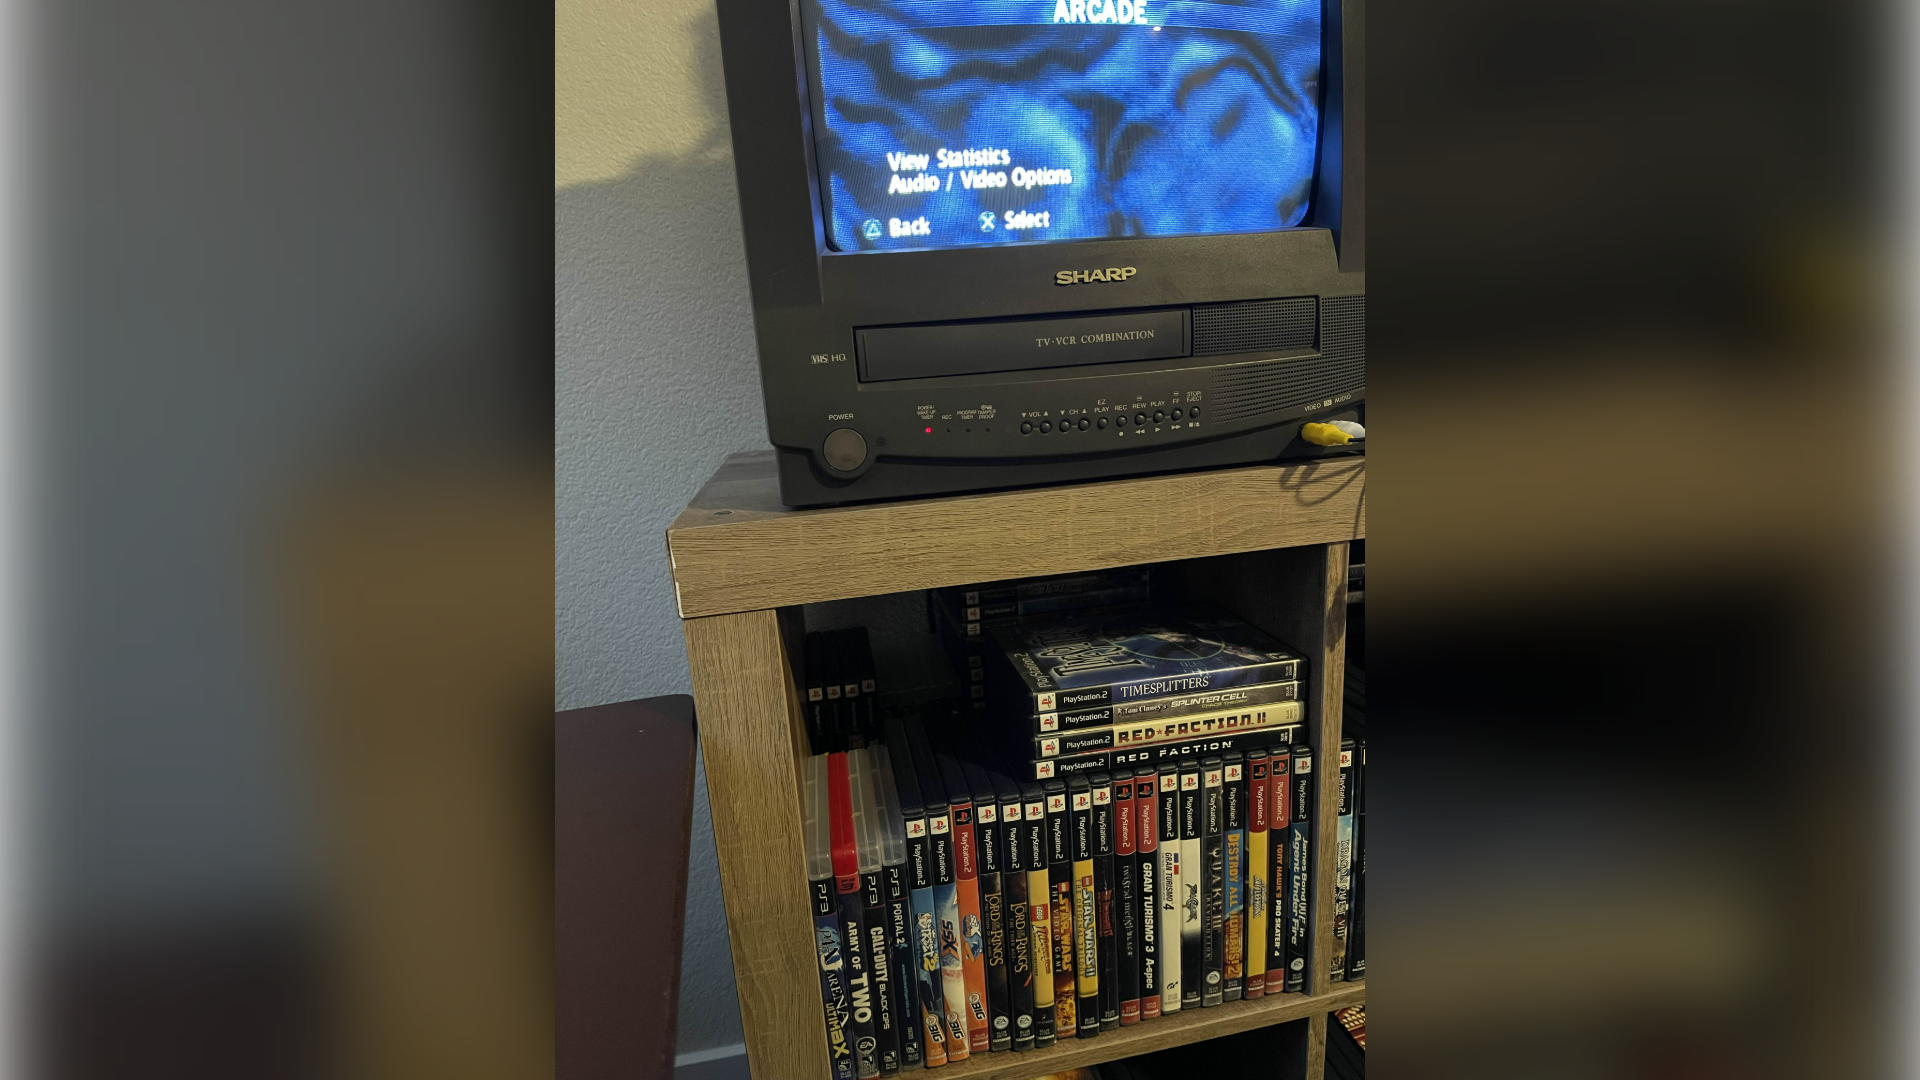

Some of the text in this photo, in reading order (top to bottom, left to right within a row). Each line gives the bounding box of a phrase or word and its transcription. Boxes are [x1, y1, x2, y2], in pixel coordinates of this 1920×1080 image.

[1053, 0, 1148, 24] ARCADE
[887, 148, 1011, 172] View Statistics
[888, 173, 941, 196] Audio
[959, 169, 1008, 190] Video
[1011, 166, 1073, 191] Options
[888, 209, 1050, 238] Back Select
[1056, 266, 1137, 285] SHARP
[1080, 329, 1155, 345] COMBINATION
[811, 354, 829, 364] VHS
[829, 413, 854, 421] POWER
[1304, 393, 1352, 412] VIDEO AUDIO
[1120, 676, 1210, 697] TIMESPLITTERS
[1170, 695, 1220, 708] SPLINTER
[1220, 692, 1248, 701] CELL
[1118, 727, 1155, 743] RED
[1164, 714, 1252, 736] FACTION
[1257, 712, 1266, 724] II
[1117, 752, 1149, 763] RED
[1159, 741, 1232, 757] FACTION
[1165, 852, 1173, 870] GRAN
[1228, 833, 1240, 883] DESTROY
[1338, 839, 1350, 884] DRAGON
[890, 868, 901, 897] PS3
[1143, 862, 1153, 893] GRAN
[1165, 872, 1174, 902] TURISMO
[1208, 847, 1222, 910] QUAKE
[1275, 868, 1283, 899] HAWK'S
[1291, 828, 1302, 945] Agent Under Fire
[985, 891, 1001, 921] LORD
[1082, 888, 1094, 928] STAR
[1163, 903, 1174, 911] 4
[1229, 886, 1238, 907] ALL
[1337, 885, 1348, 915] QUEST
[893, 903, 904, 937] PORTAL
[1010, 901, 1027, 930] LORD
[1058, 893, 1071, 933] STAR
[1143, 895, 1154, 942] TURISMO
[1212, 915, 1222, 929] III
[942, 919, 960, 958] SSX
[1229, 910, 1240, 964] HUMANS!
[1299, 928, 1306, 938] in
[1336, 919, 1346, 937] VIII
[818, 883, 849, 1028] PS3 ARENA
[868, 876, 890, 1030] PS3 CALL DUTY BLACK OPS
[989, 929, 1004, 967] RINGS
[1014, 937, 1028, 973] RINGS
[1054, 946, 1062, 973] GAME
[1060, 933, 1072, 972] WARS
[1084, 927, 1096, 967] WARS
[1145, 945, 1154, 953] 3
[847, 921, 872, 1024] ARMY OF TWO
[1085, 967, 1096, 978] II
[1144, 958, 1155, 989] A-spec
[1227, 964, 1240, 975] 2
[971, 1001, 986, 1020] BIG
[929, 1024, 943, 1042] BIG
[949, 1020, 964, 1040] BIG
